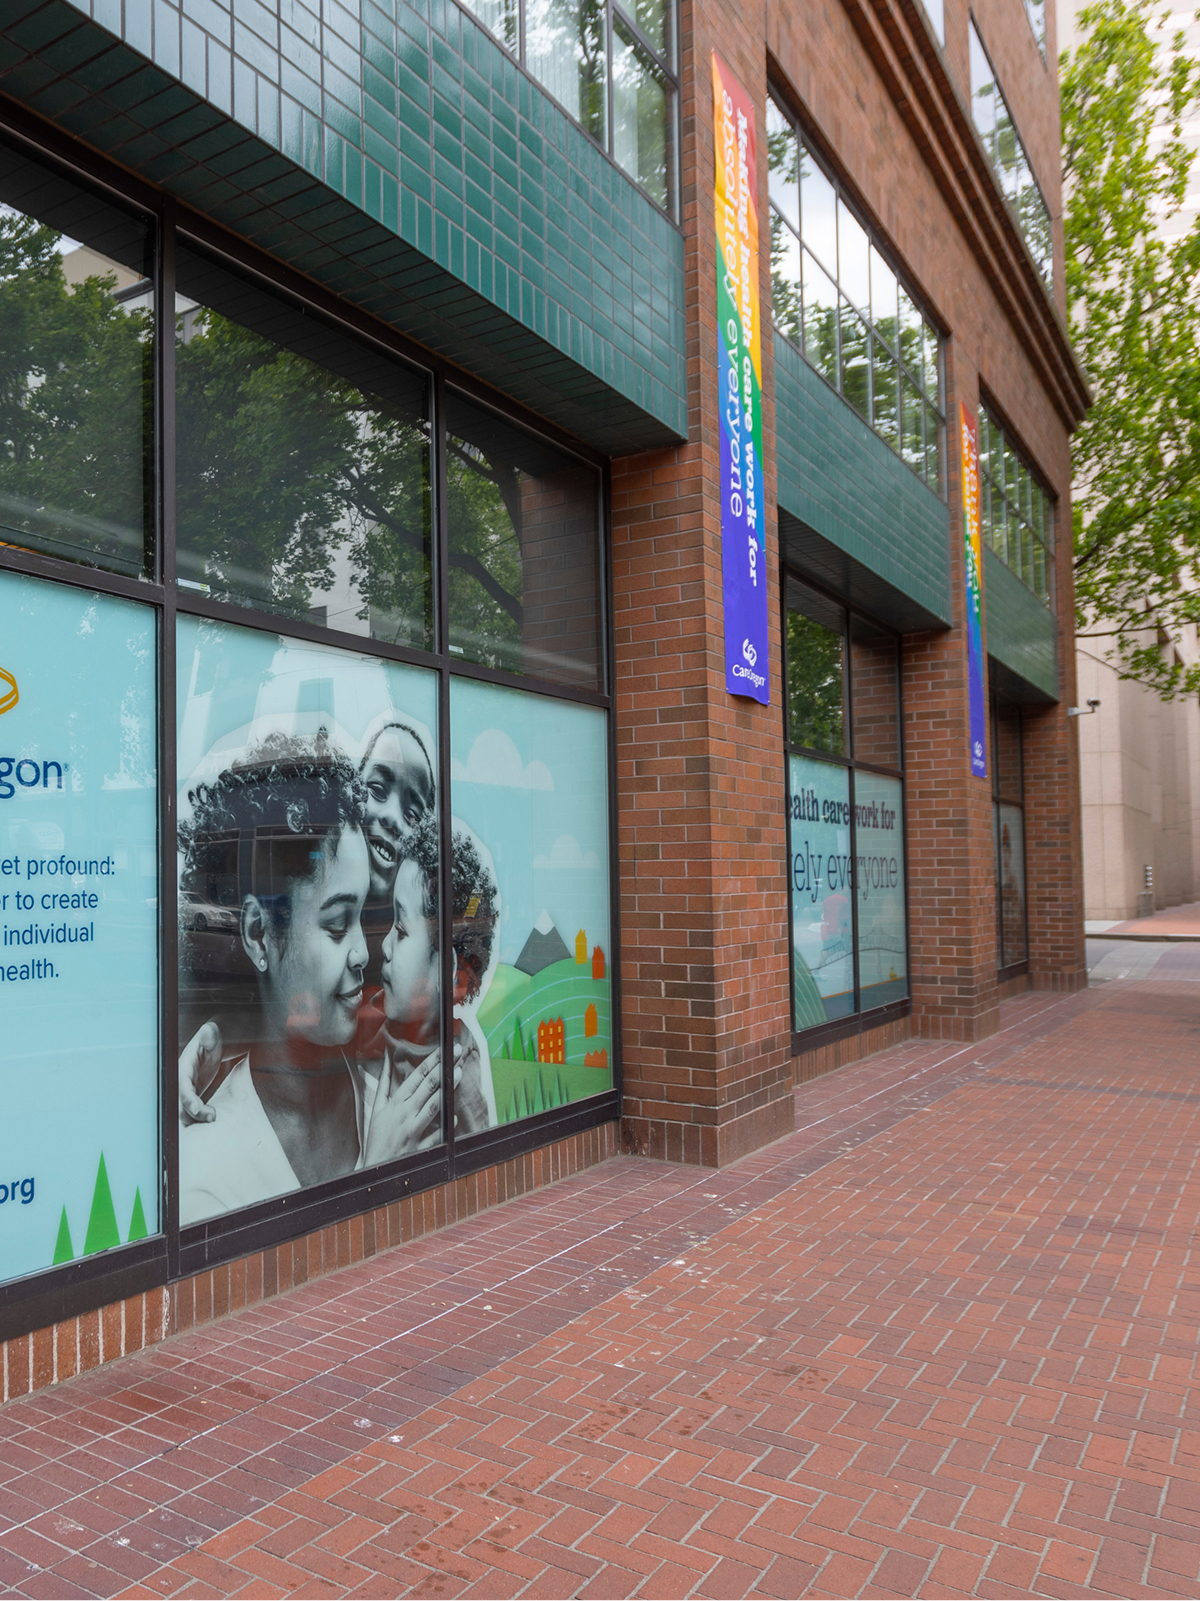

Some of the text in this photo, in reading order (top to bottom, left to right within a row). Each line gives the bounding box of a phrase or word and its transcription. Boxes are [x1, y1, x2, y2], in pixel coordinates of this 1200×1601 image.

[722, 89, 743, 518] absolutely everyone
[737, 107, 758, 587] Making health care work for
[823, 800, 850, 826] care
[881, 801, 896, 830] for
[27, 855, 116, 881] profound:
[791, 841, 822, 903] ely
[15, 890, 35, 911] to
[41, 890, 99, 910] create
[3, 921, 94, 946] individual
